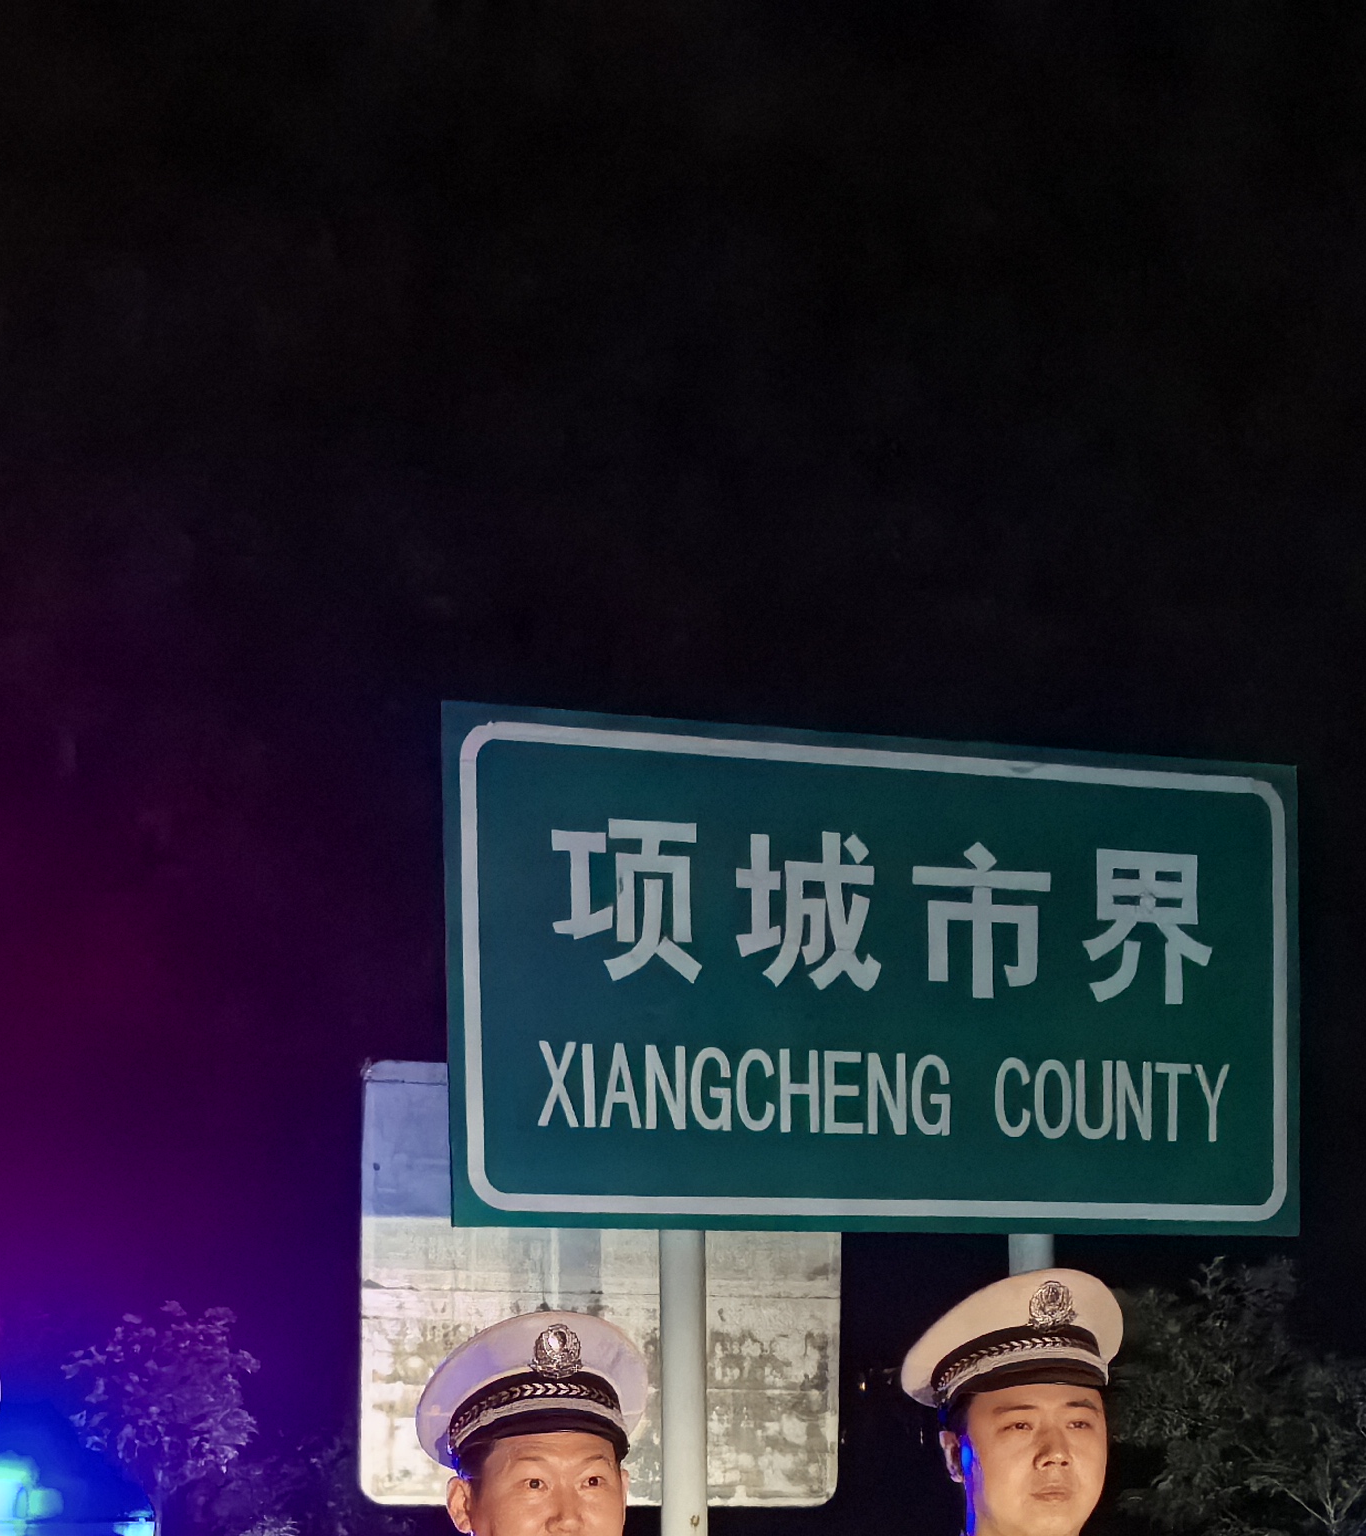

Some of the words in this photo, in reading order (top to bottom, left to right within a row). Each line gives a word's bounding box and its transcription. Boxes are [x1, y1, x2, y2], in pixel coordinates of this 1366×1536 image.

[550, 817, 1214, 1005] 项城市界
[537, 1039, 953, 1137] XIANGCHENG
[993, 1057, 1230, 1143] COUNTY
